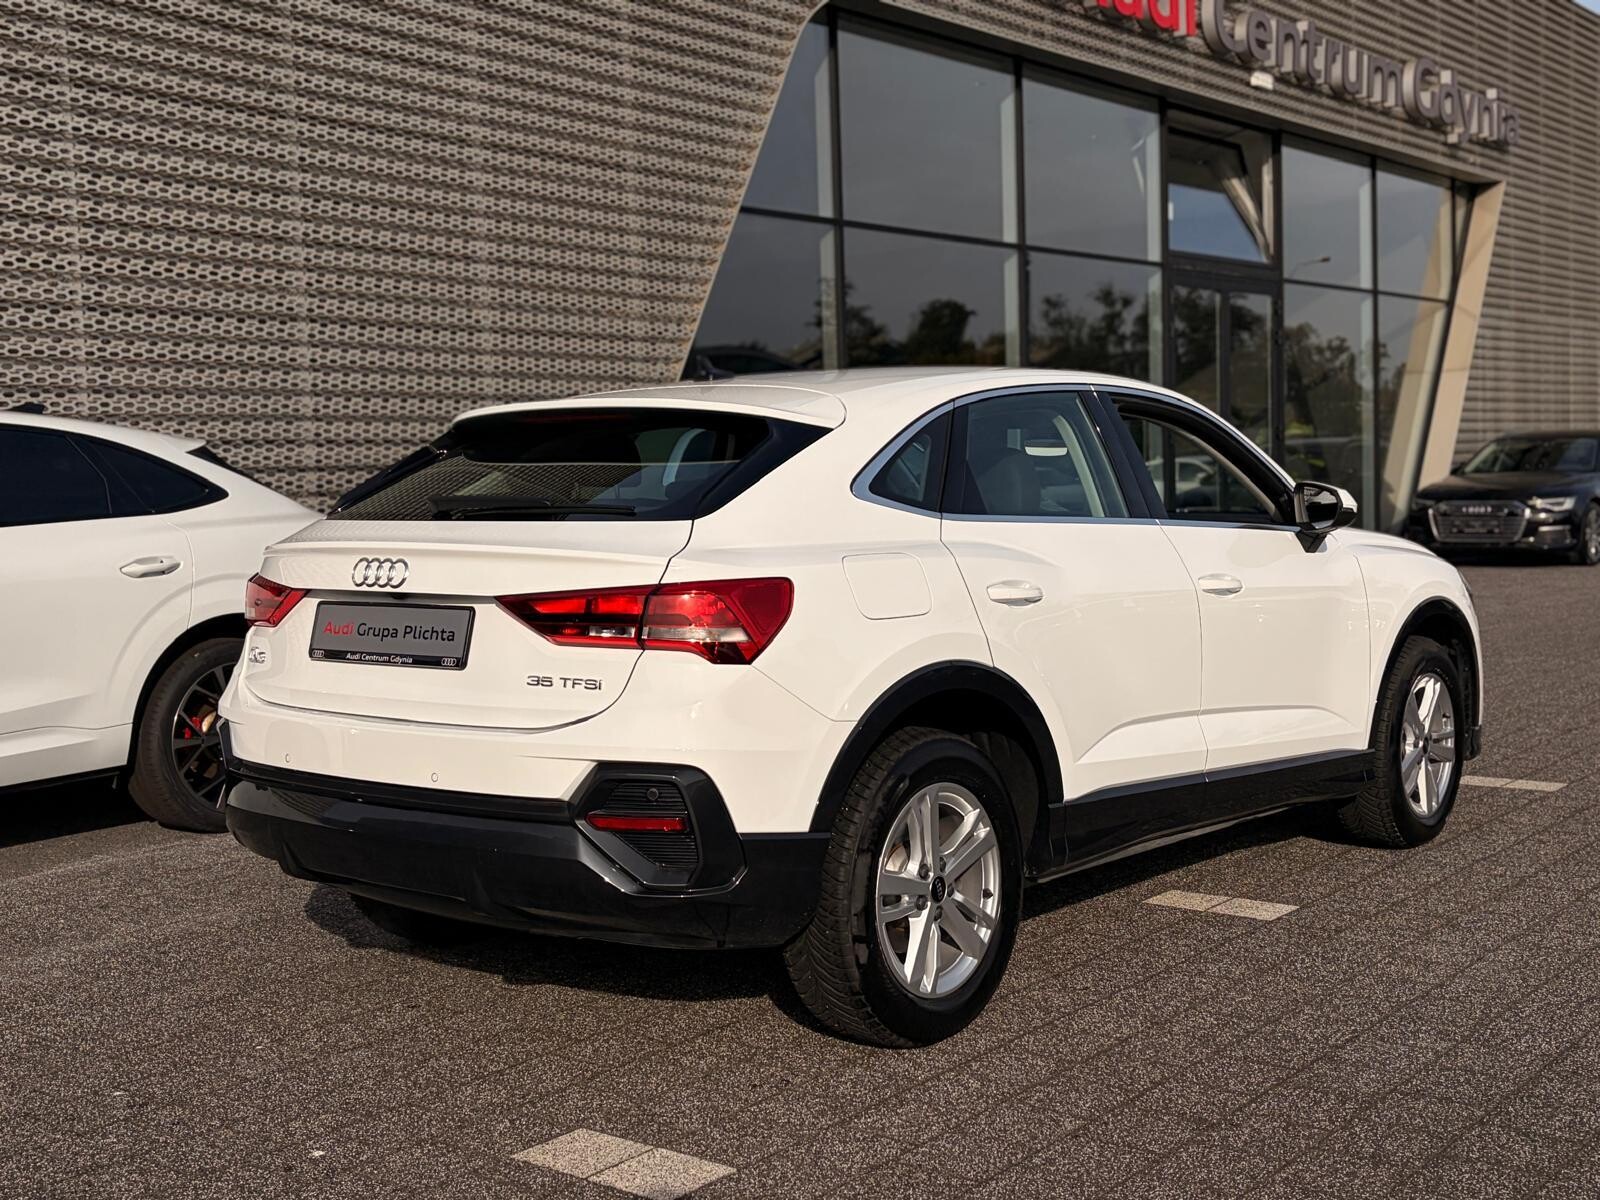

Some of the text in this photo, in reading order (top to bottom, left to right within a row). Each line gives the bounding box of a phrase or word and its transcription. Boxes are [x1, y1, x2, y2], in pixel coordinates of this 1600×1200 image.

[1200, 0, 1403, 107] Centrum
[1403, 56, 1520, 144] Gdynia
[324, 622, 455, 642] Audi Grupa Plichta
[346, 652, 413, 664] Audi Centrum Gdynia
[526, 675, 553, 687] 35
